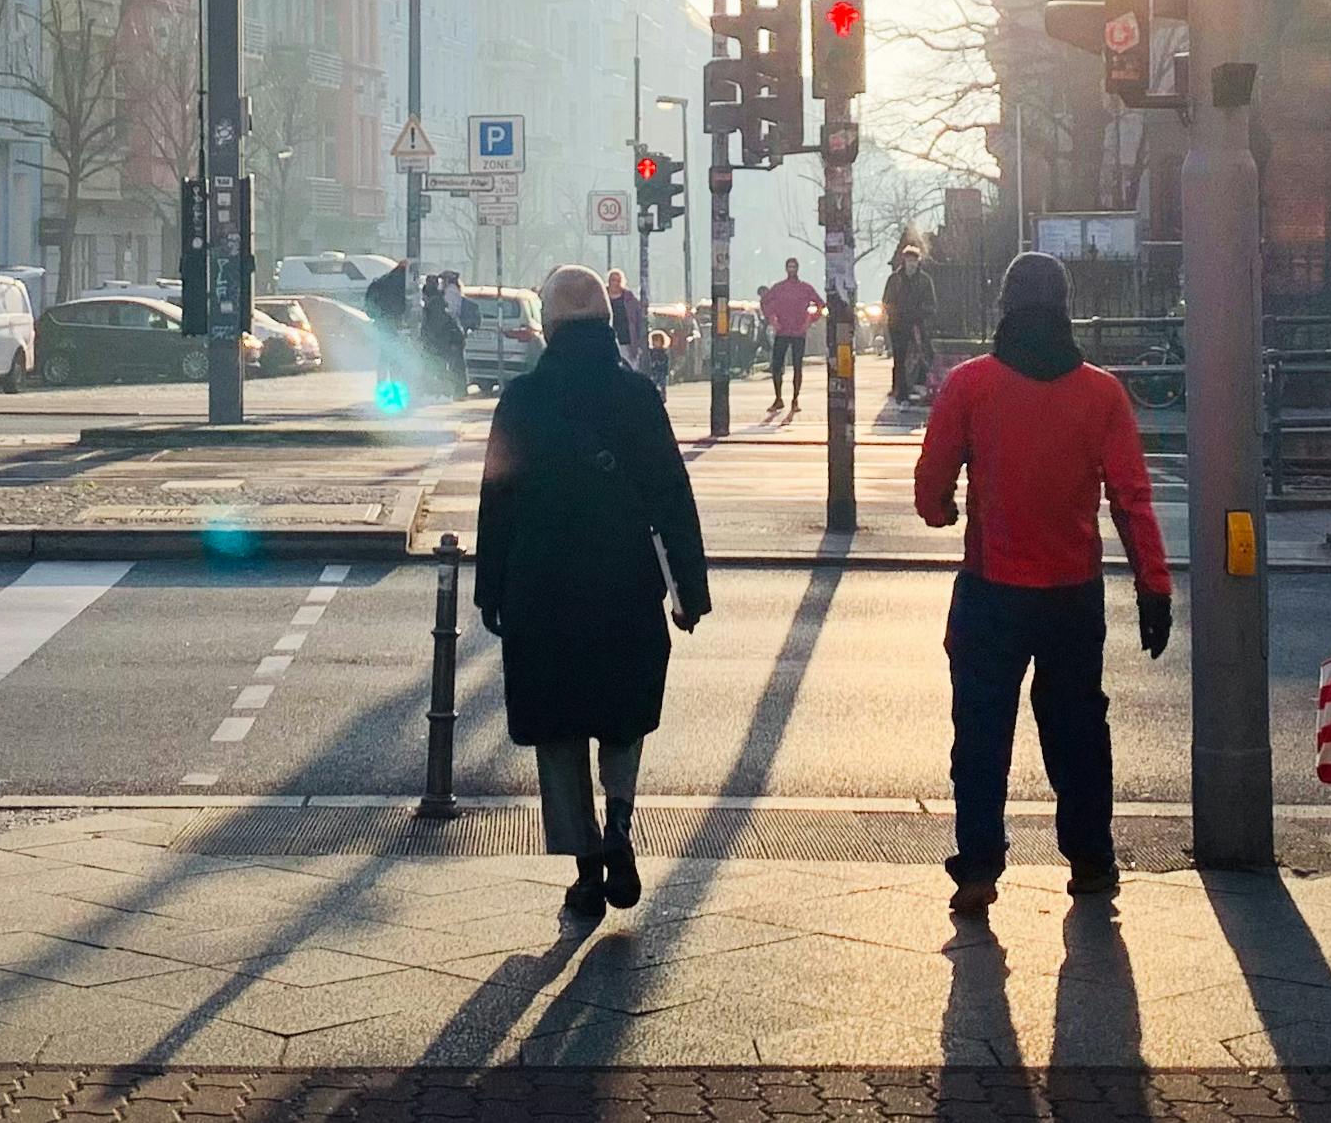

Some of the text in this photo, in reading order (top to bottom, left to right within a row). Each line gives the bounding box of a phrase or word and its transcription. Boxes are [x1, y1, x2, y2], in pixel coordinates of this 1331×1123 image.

[487, 126, 506, 153] P
[482, 160, 511, 170] ZONE
[602, 203, 617, 215] 30
